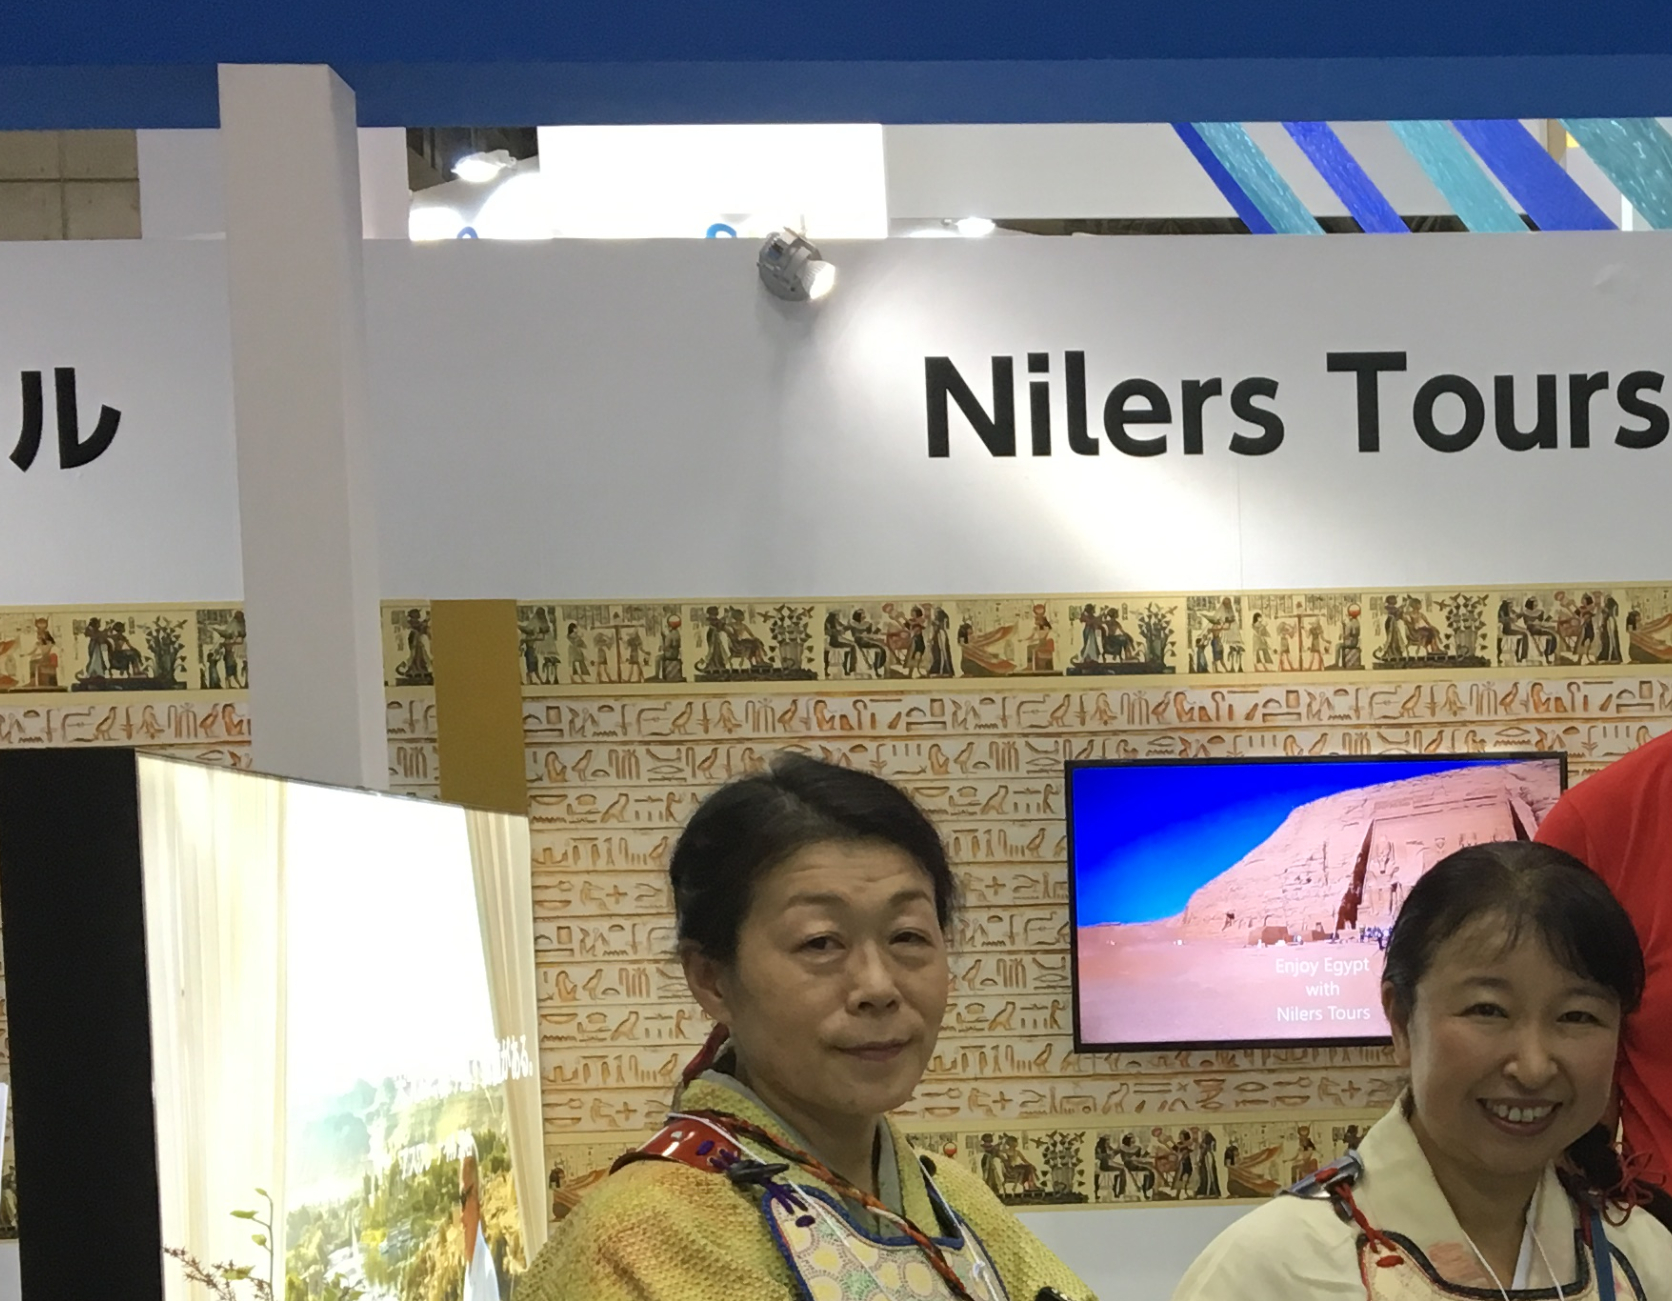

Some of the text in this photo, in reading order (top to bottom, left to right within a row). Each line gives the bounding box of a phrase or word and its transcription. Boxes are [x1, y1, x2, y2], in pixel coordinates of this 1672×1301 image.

[924, 350, 1670, 458] Nilers Tours
[1275, 957, 1370, 976] Enjoy Egypt
[1305, 982, 1340, 996] with
[1276, 1005, 1371, 1022] Nilers Tours
